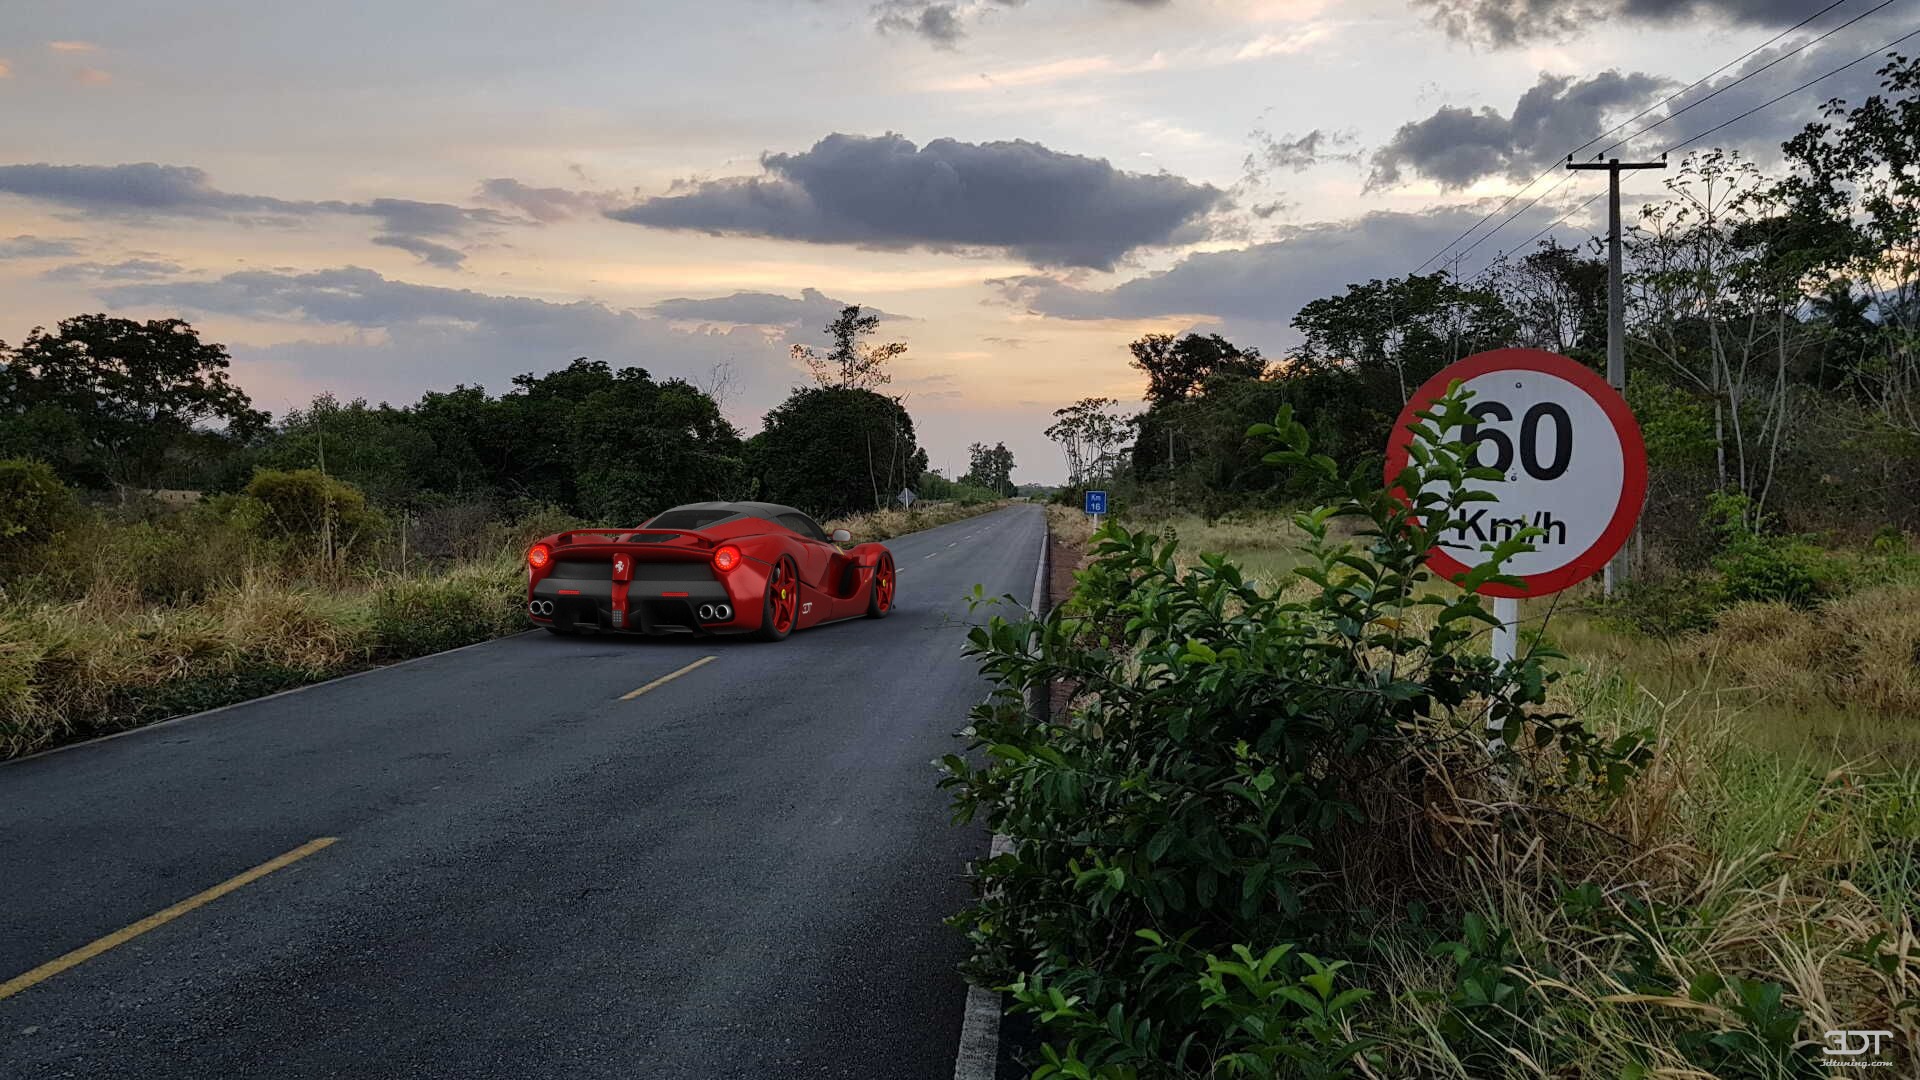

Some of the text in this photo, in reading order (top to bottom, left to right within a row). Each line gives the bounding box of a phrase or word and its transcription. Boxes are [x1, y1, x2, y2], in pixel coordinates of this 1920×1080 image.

[1460, 400, 1573, 481] 60
[1091, 503, 1101, 511] 16
[1456, 508, 1566, 545] Km/h
